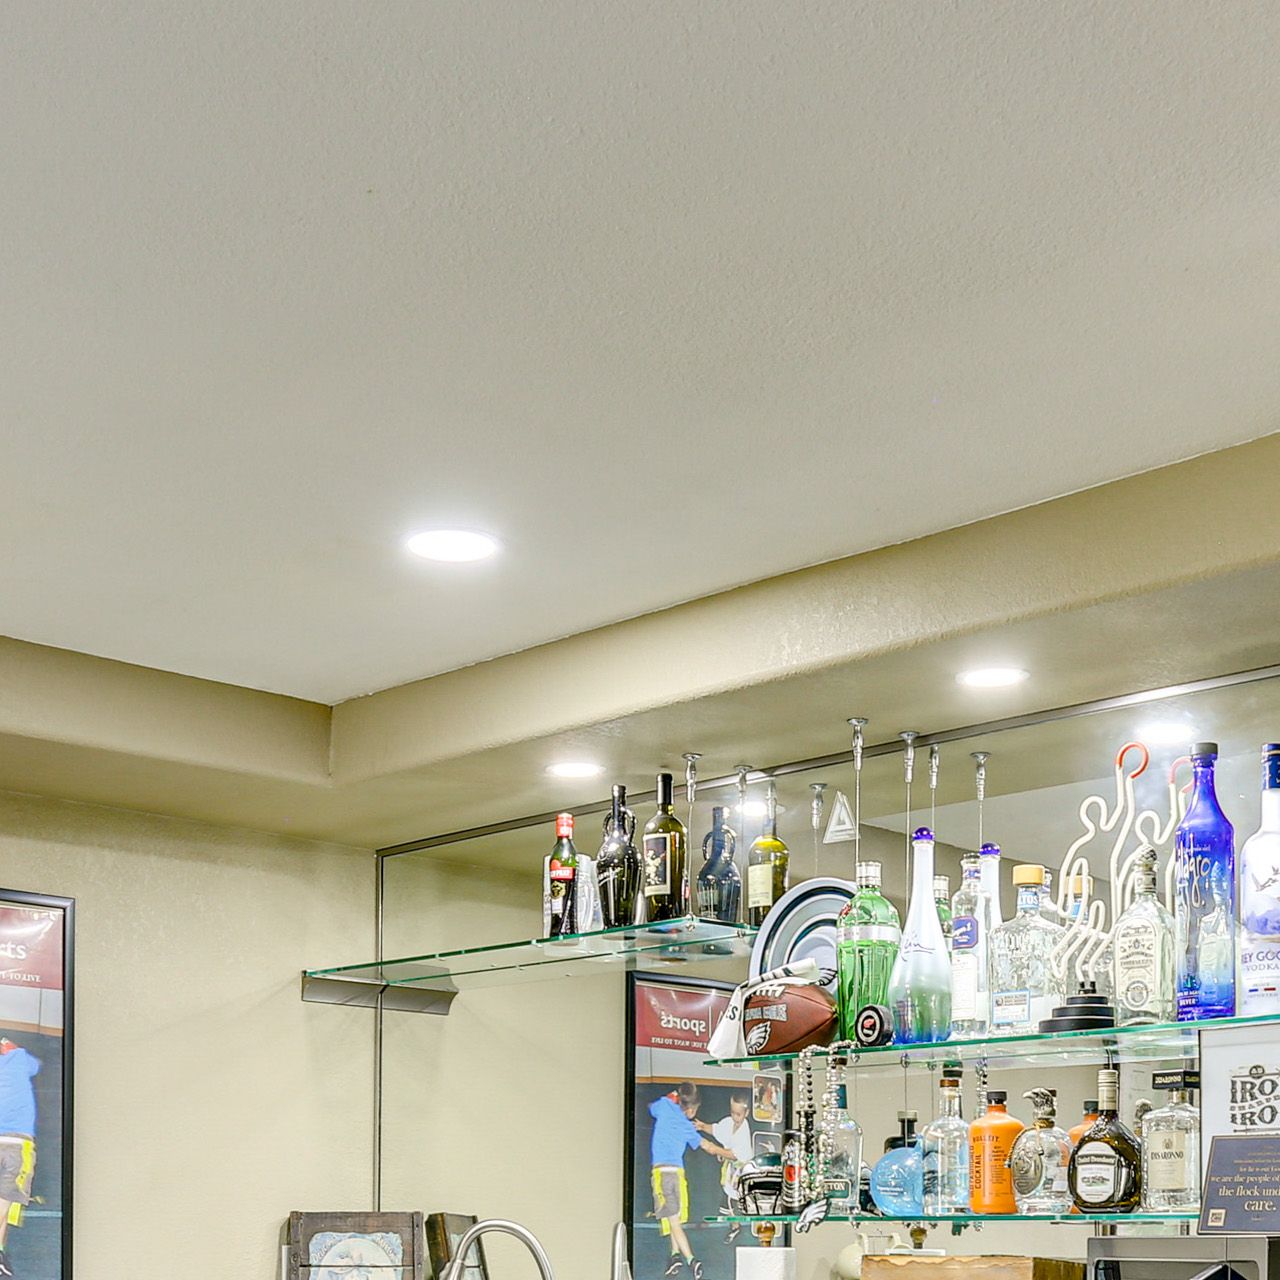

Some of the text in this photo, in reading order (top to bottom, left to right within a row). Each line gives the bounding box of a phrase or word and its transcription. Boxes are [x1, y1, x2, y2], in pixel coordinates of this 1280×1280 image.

[1246, 1174, 1270, 1183] people
[1218, 1185, 1234, 1196] the
[1235, 1185, 1260, 1196] flock
[1244, 1200, 1277, 1211] care.
